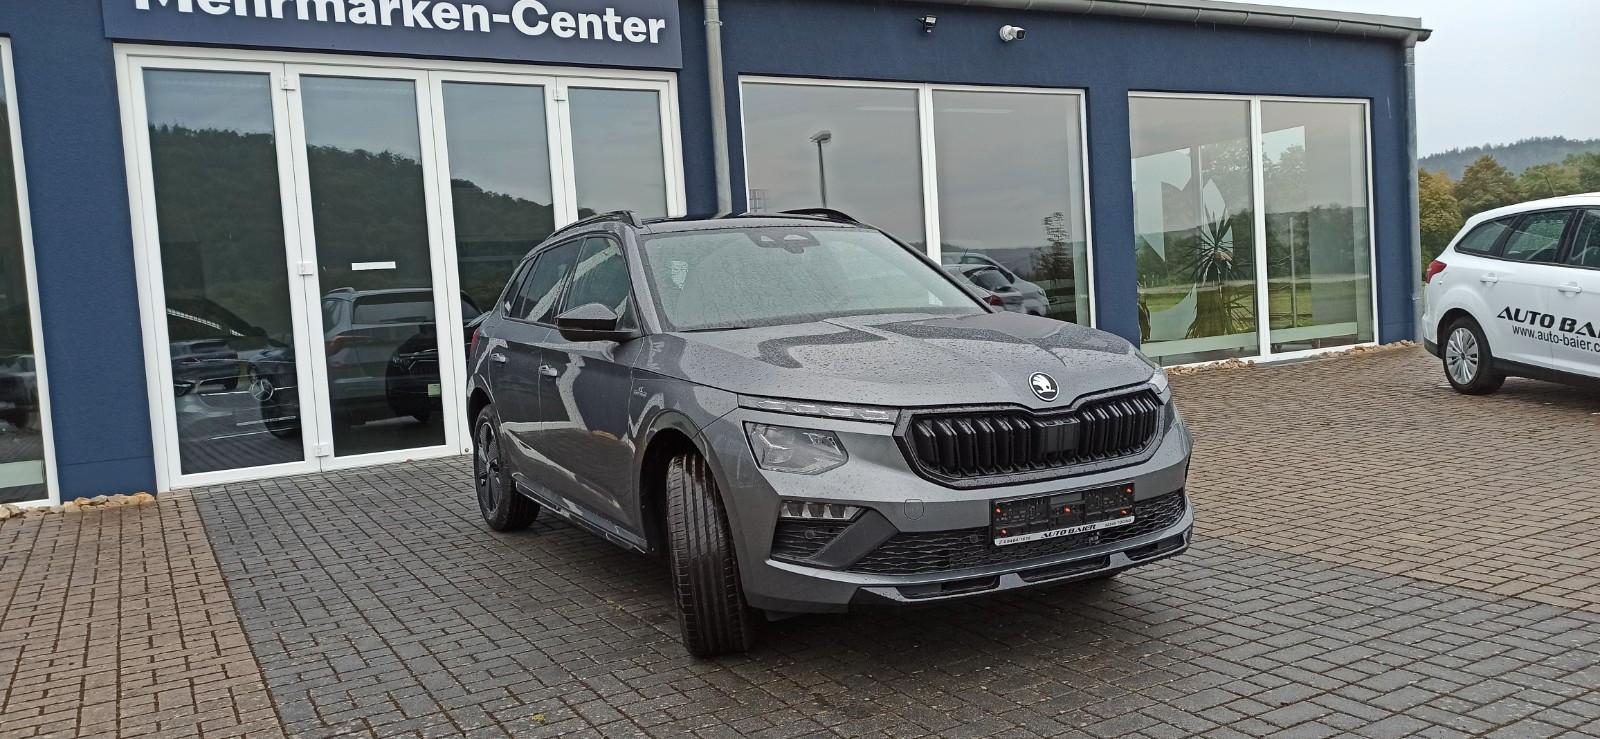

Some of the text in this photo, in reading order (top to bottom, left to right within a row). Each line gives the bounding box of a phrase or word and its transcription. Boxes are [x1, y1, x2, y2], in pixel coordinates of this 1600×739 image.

[135, 0, 666, 44] ermarken-Center
[1496, 305, 1600, 339] AUTO BA
[1040, 528, 1067, 539] AUTO
